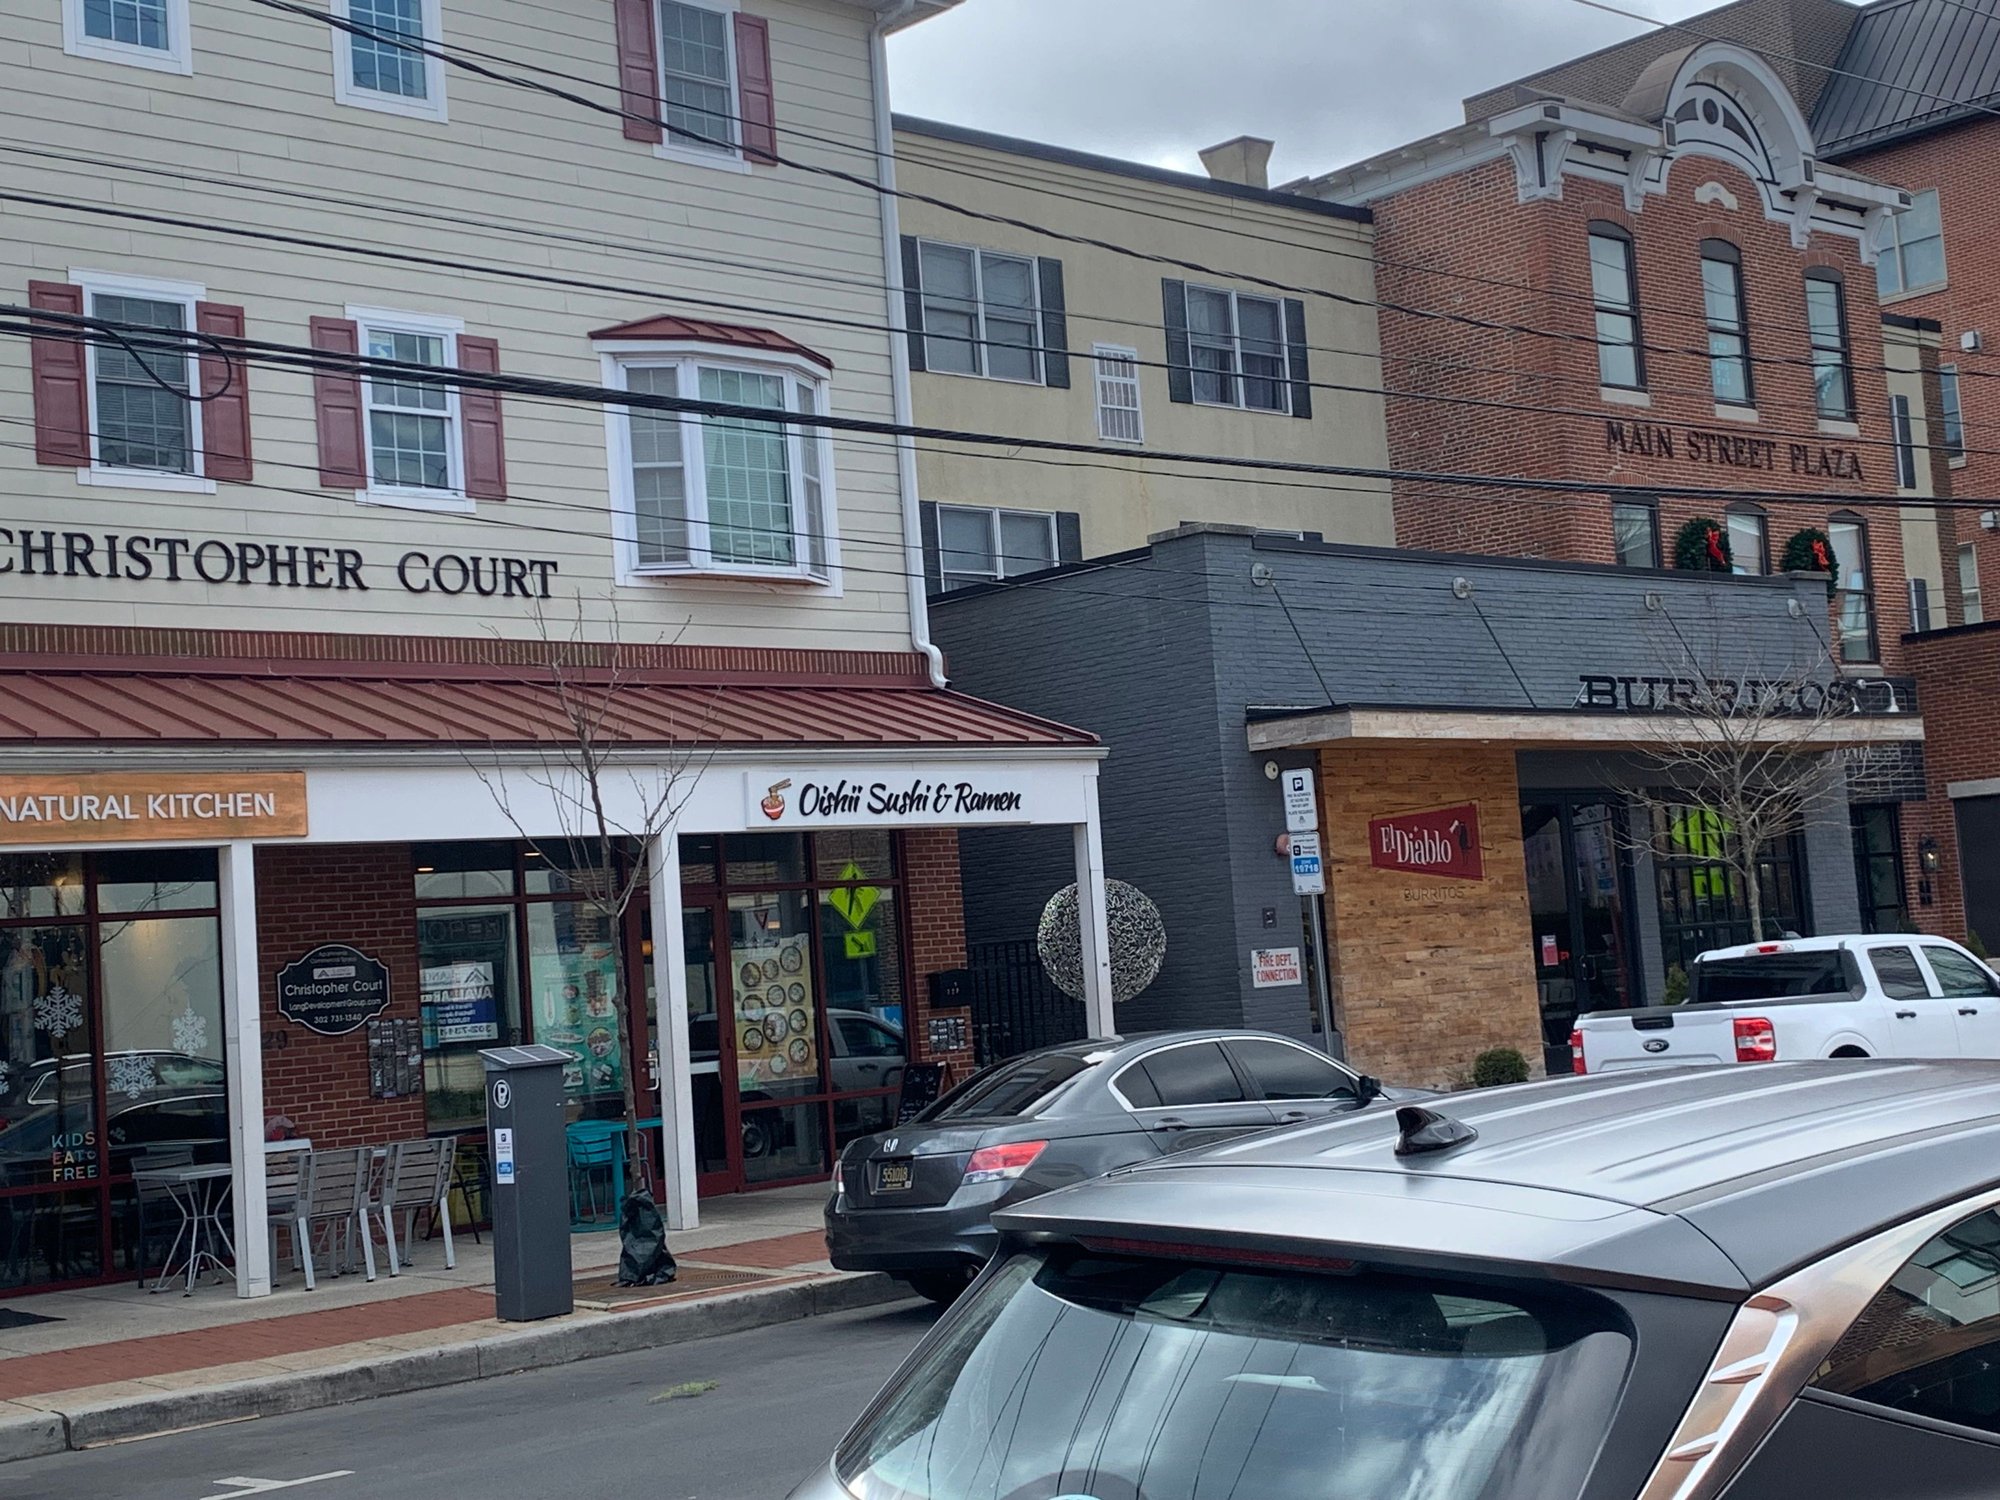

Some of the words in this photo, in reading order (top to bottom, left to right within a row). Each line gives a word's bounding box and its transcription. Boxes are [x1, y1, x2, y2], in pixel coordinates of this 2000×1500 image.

[1605, 421, 1674, 458] MAIN
[1687, 431, 1777, 470] STREET
[1789, 444, 1863, 480] PLAZA
[0, 528, 369, 591] CHRISTOPHER
[397, 551, 558, 598] COURT
[800, 780, 863, 816] Oishii
[867, 779, 932, 815] Sushi
[933, 783, 952, 814] &
[954, 782, 1022, 813] Ramen
[0, 794, 139, 822] NATURAL
[148, 792, 276, 819] KITCHEN
[1404, 887, 1464, 901] BURRITOS
[1257, 968, 1298, 982] CONNECTION
[284, 982, 349, 996] Christopher
[353, 979, 382, 992] Court
[51, 1131, 96, 1148] KIDS
[52, 1150, 84, 1165] EAT
[53, 1165, 98, 1182] FREE
